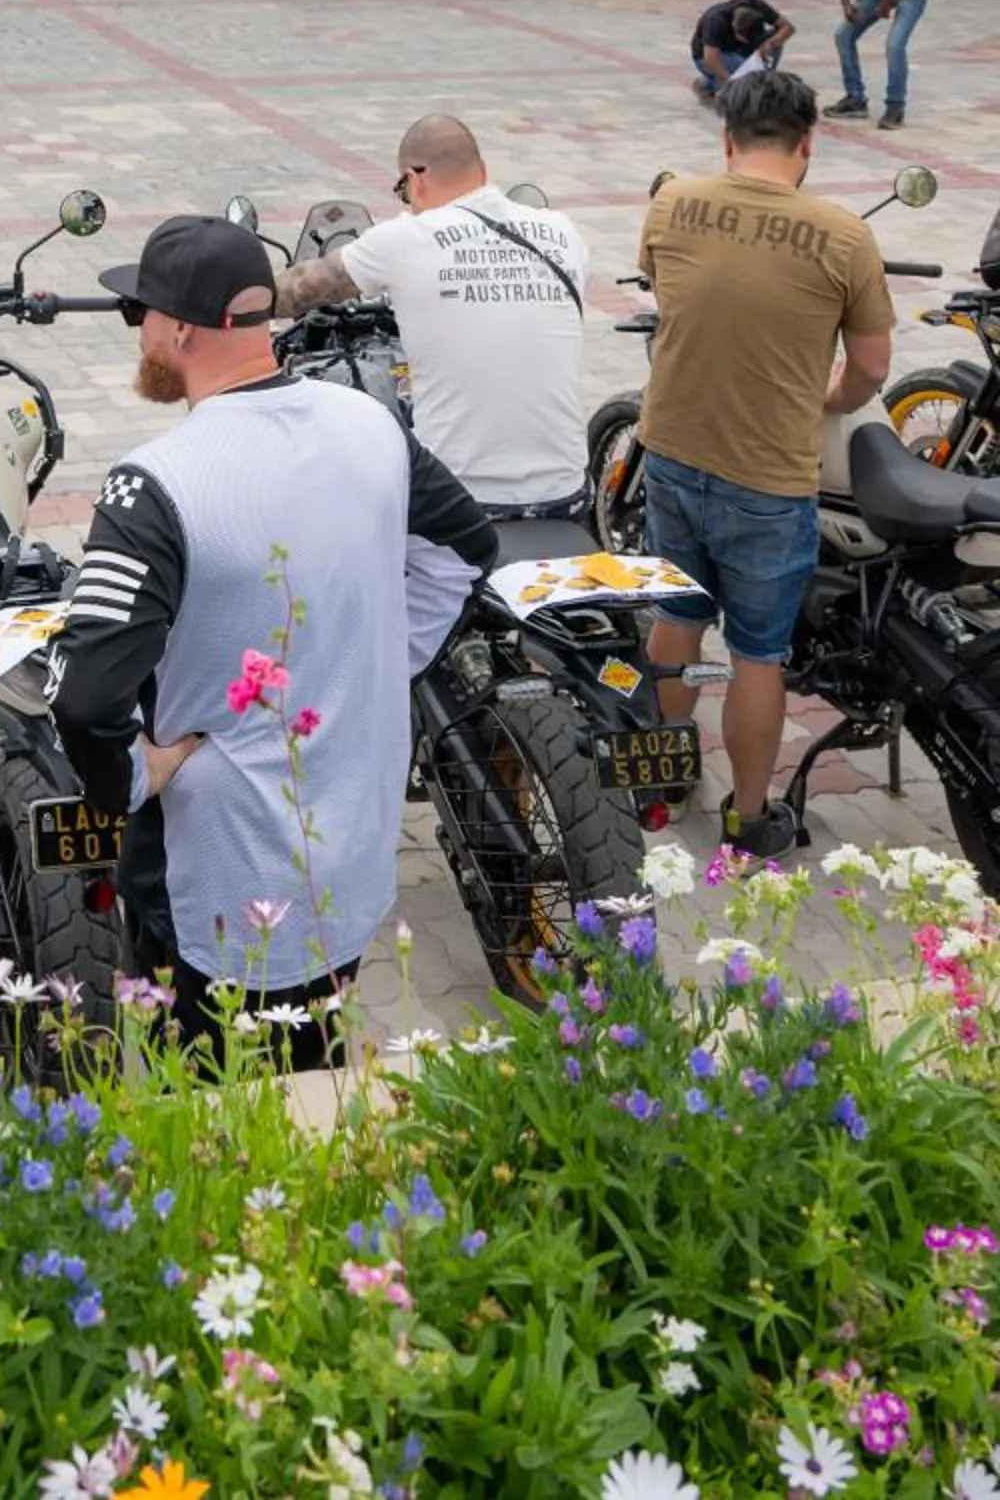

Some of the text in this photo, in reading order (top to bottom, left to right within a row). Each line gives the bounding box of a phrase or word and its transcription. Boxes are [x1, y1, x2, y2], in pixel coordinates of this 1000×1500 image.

[670, 196, 831, 254] MLG 1901
[439, 267, 491, 282] GENUINE
[494, 267, 530, 282] PARTS
[463, 283, 563, 303] AUSTRALIA
[615, 756, 695, 786] 5802
